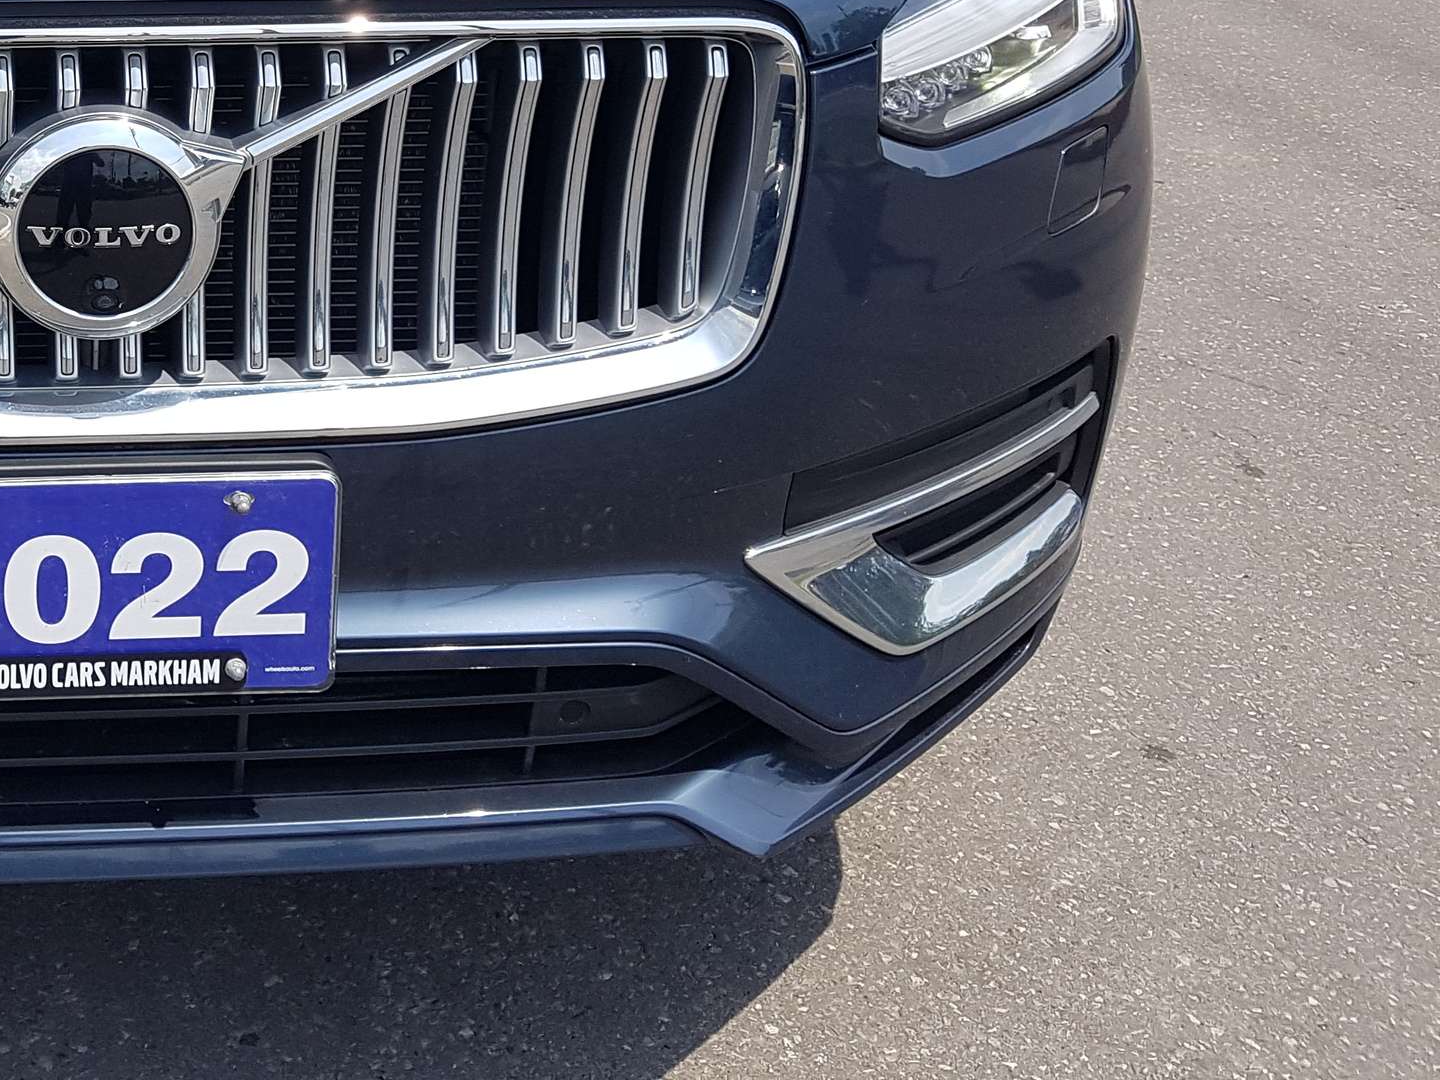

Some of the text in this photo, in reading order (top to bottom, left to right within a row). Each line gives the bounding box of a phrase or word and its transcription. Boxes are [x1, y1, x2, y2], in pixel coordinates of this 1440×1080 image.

[27, 223, 182, 248] VOLVO
[52, 661, 106, 688] CARS
[111, 658, 221, 686] MARKHAM
